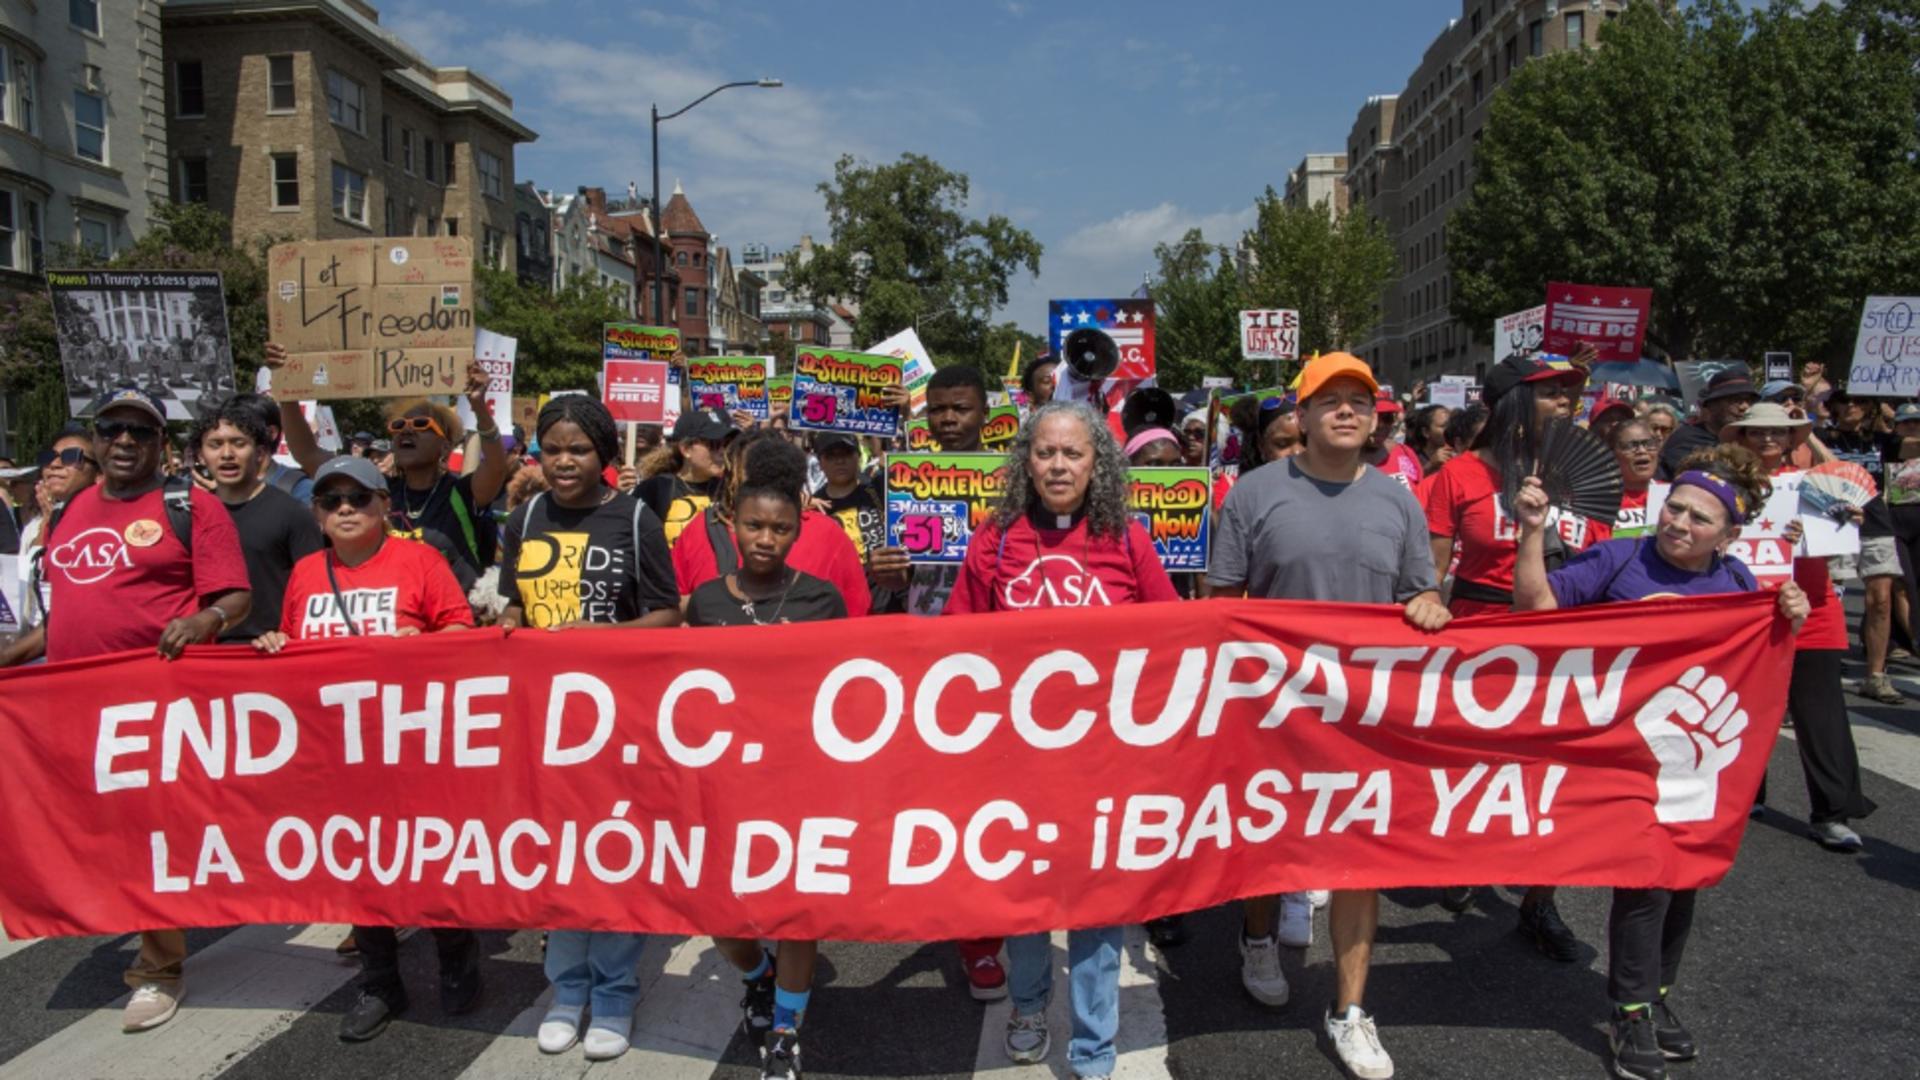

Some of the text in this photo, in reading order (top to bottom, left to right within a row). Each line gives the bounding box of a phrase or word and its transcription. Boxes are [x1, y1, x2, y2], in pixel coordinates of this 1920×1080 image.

[48, 273, 219, 290] Pawns in Trump's chess game
[302, 255, 341, 327] Let
[335, 288, 470, 350] Freedom
[1247, 312, 1297, 329] ICE
[1550, 318, 1602, 336] FREE
[1605, 322, 1636, 337] DC
[609, 392, 660, 402] FREE DC
[858, 382, 885, 411] NO
[914, 461, 1008, 499] STATEHO
[50, 542, 135, 569] CASA
[308, 591, 393, 618] UNITE
[1004, 575, 1112, 608] CASA
[94, 641, 1639, 794] END THE D.C. OCCUPATION
[151, 763, 1568, 897] LA OCUPACIÓN DE DC: ¡BASTA YA!
